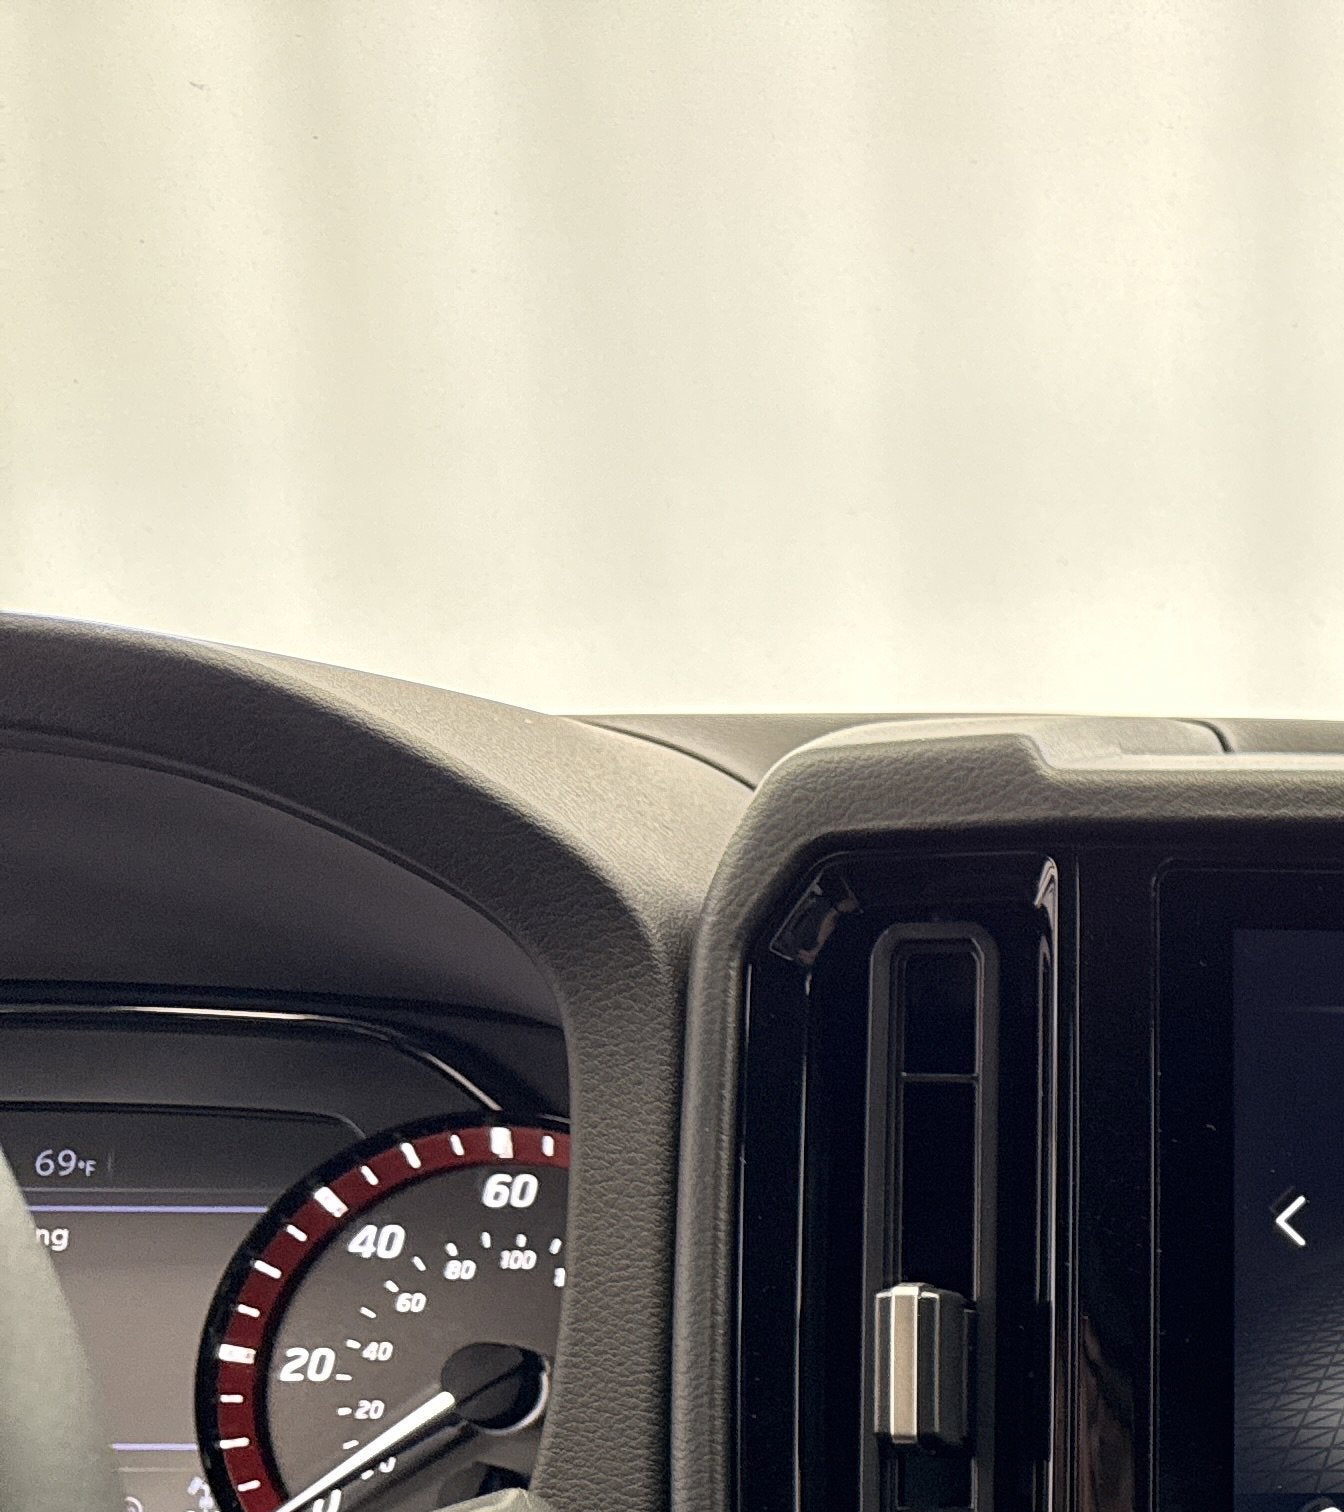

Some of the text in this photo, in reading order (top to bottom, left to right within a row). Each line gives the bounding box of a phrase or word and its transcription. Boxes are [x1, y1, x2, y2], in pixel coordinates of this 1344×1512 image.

[481, 1172, 538, 1209] 60
[347, 1223, 406, 1260] 40
[443, 1257, 477, 1281] 80
[499, 1249, 538, 1270] 100
[395, 1292, 427, 1314] 60
[362, 1341, 394, 1363] 40
[278, 1346, 335, 1382] 20
[355, 1399, 385, 1421] 20
